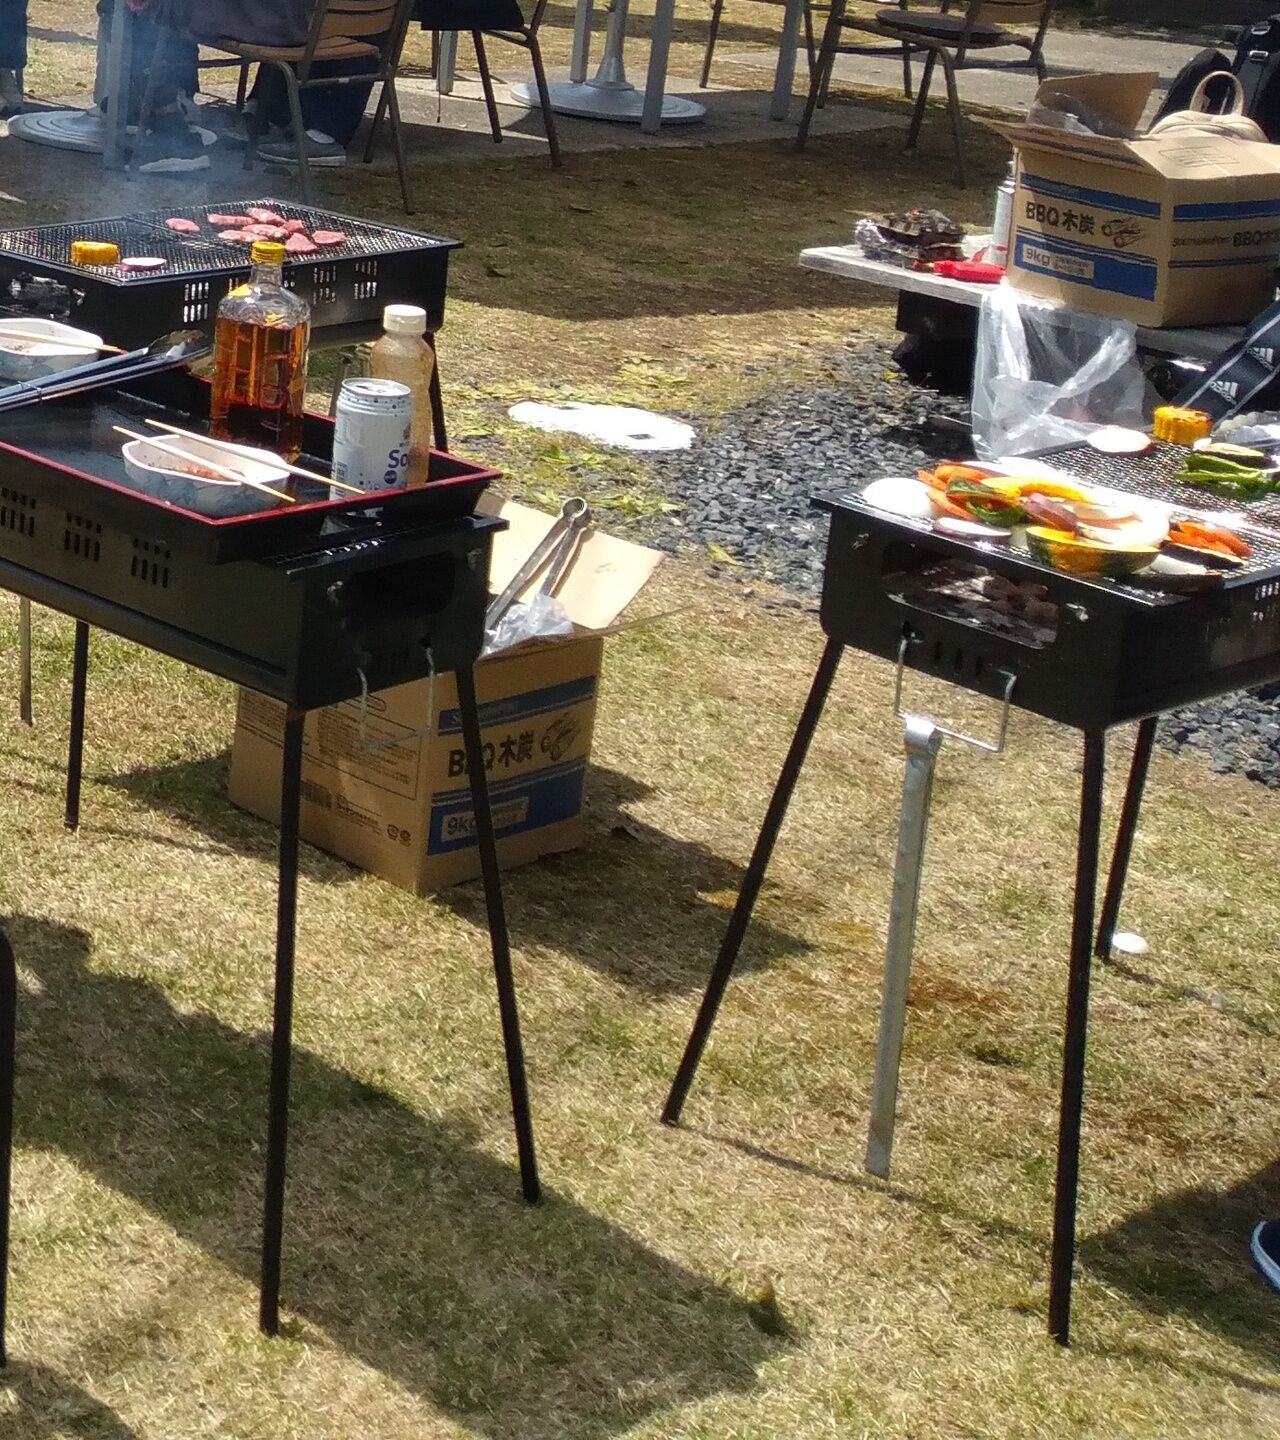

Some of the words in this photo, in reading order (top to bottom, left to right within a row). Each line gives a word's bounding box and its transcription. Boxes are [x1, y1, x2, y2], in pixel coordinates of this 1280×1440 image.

[1026, 200, 1095, 236] BBQ木炭
[1026, 248, 1051, 267] 9kg
[448, 730, 534, 778] BQ木炭
